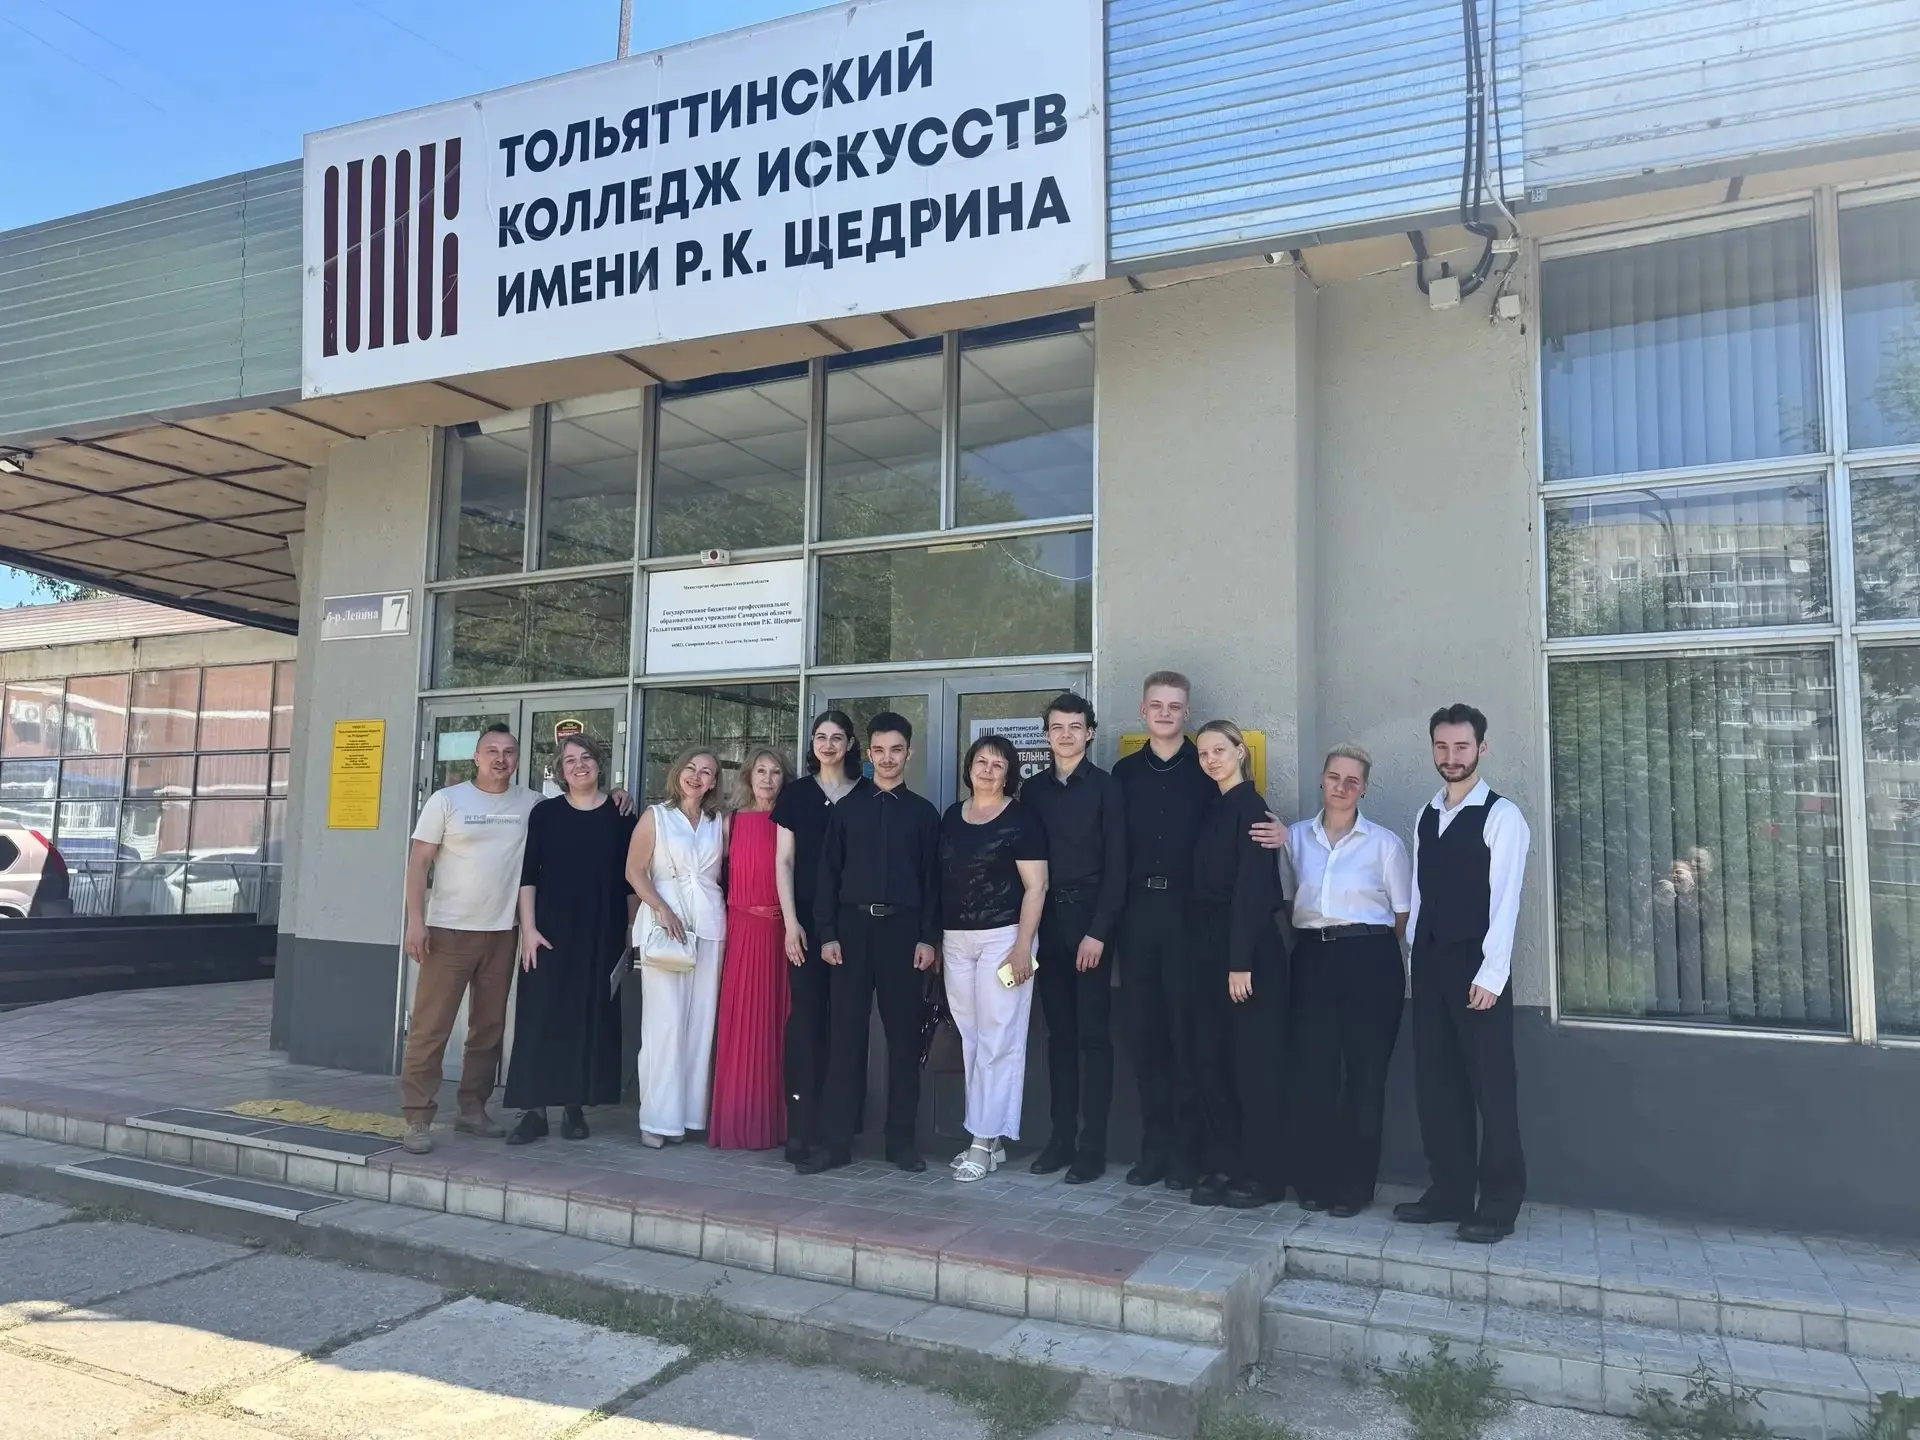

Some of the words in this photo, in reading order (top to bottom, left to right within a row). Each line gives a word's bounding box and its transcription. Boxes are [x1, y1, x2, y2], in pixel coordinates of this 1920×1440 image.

[498, 28, 933, 178] ТОЛЬЯТТИНСКИЙ
[498, 157, 741, 248] КОЛЛЕДЖ
[757, 93, 1069, 197] ИСКУССТВ
[497, 246, 658, 318] ИМЕНИ
[784, 175, 1071, 271] ЩЕДРИНА
[391, 598, 405, 627] 7
[662, 608, 706, 616] Государственное
[707, 605, 737, 613] бюджетное
[737, 601, 790, 611] профессиональное
[326, 611, 341, 625] б-р
[342, 609, 379, 622] Ленина
[660, 616, 704, 625] образовательное
[704, 613, 737, 622] учреждение
[737, 611, 769, 619] Самарской
[996, 724, 1039, 732] ТОЛЬЯТТИНСКИЙ
[1017, 751, 1051, 762] ТЕЛЬНЫЕ
